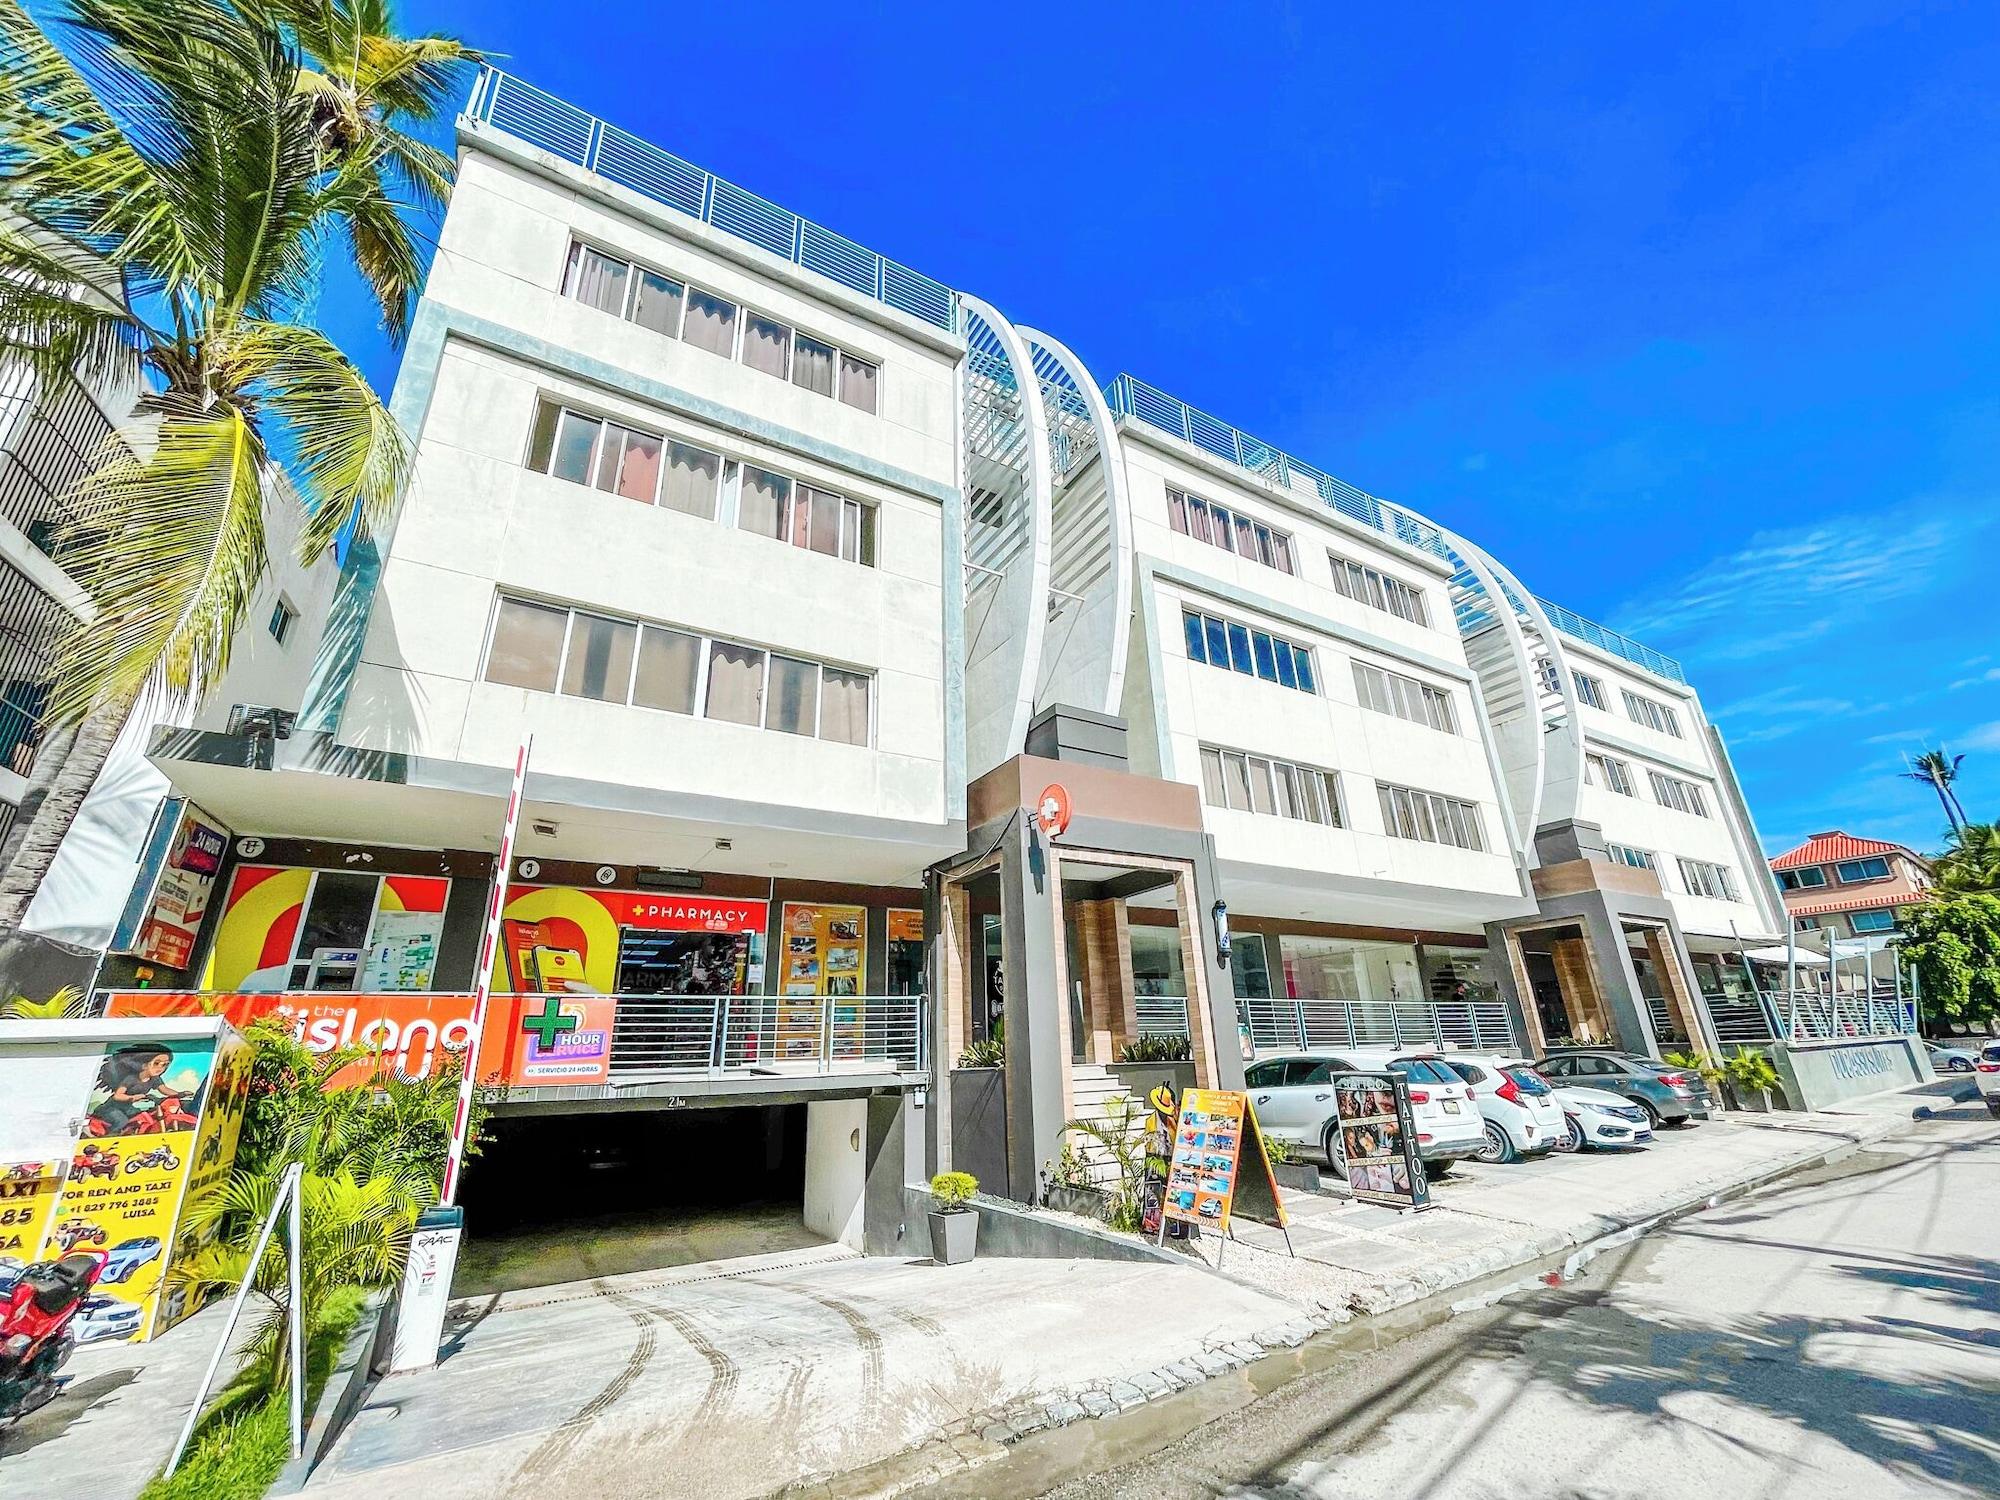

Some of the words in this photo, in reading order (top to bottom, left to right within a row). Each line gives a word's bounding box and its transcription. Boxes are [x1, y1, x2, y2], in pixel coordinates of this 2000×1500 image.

[648, 905, 748, 922] PHARMACY
[314, 1004, 345, 1017] the
[561, 1033, 601, 1046] HOUR
[537, 1065, 567, 1075] SERVICIO
[568, 1065, 577, 1073] 24
[577, 1064, 599, 1073] HORAS
[1396, 1082, 1426, 1196] TATTOO
[61, 1190, 85, 1200] FOR
[87, 1188, 112, 1198] REN
[115, 1185, 141, 1195] AND
[145, 1181, 173, 1192] TAXI
[83, 1203, 107, 1212] 829
[108, 1199, 129, 1210] 796
[132, 1197, 159, 1207] 3885
[122, 1208, 156, 1219] LUISA
